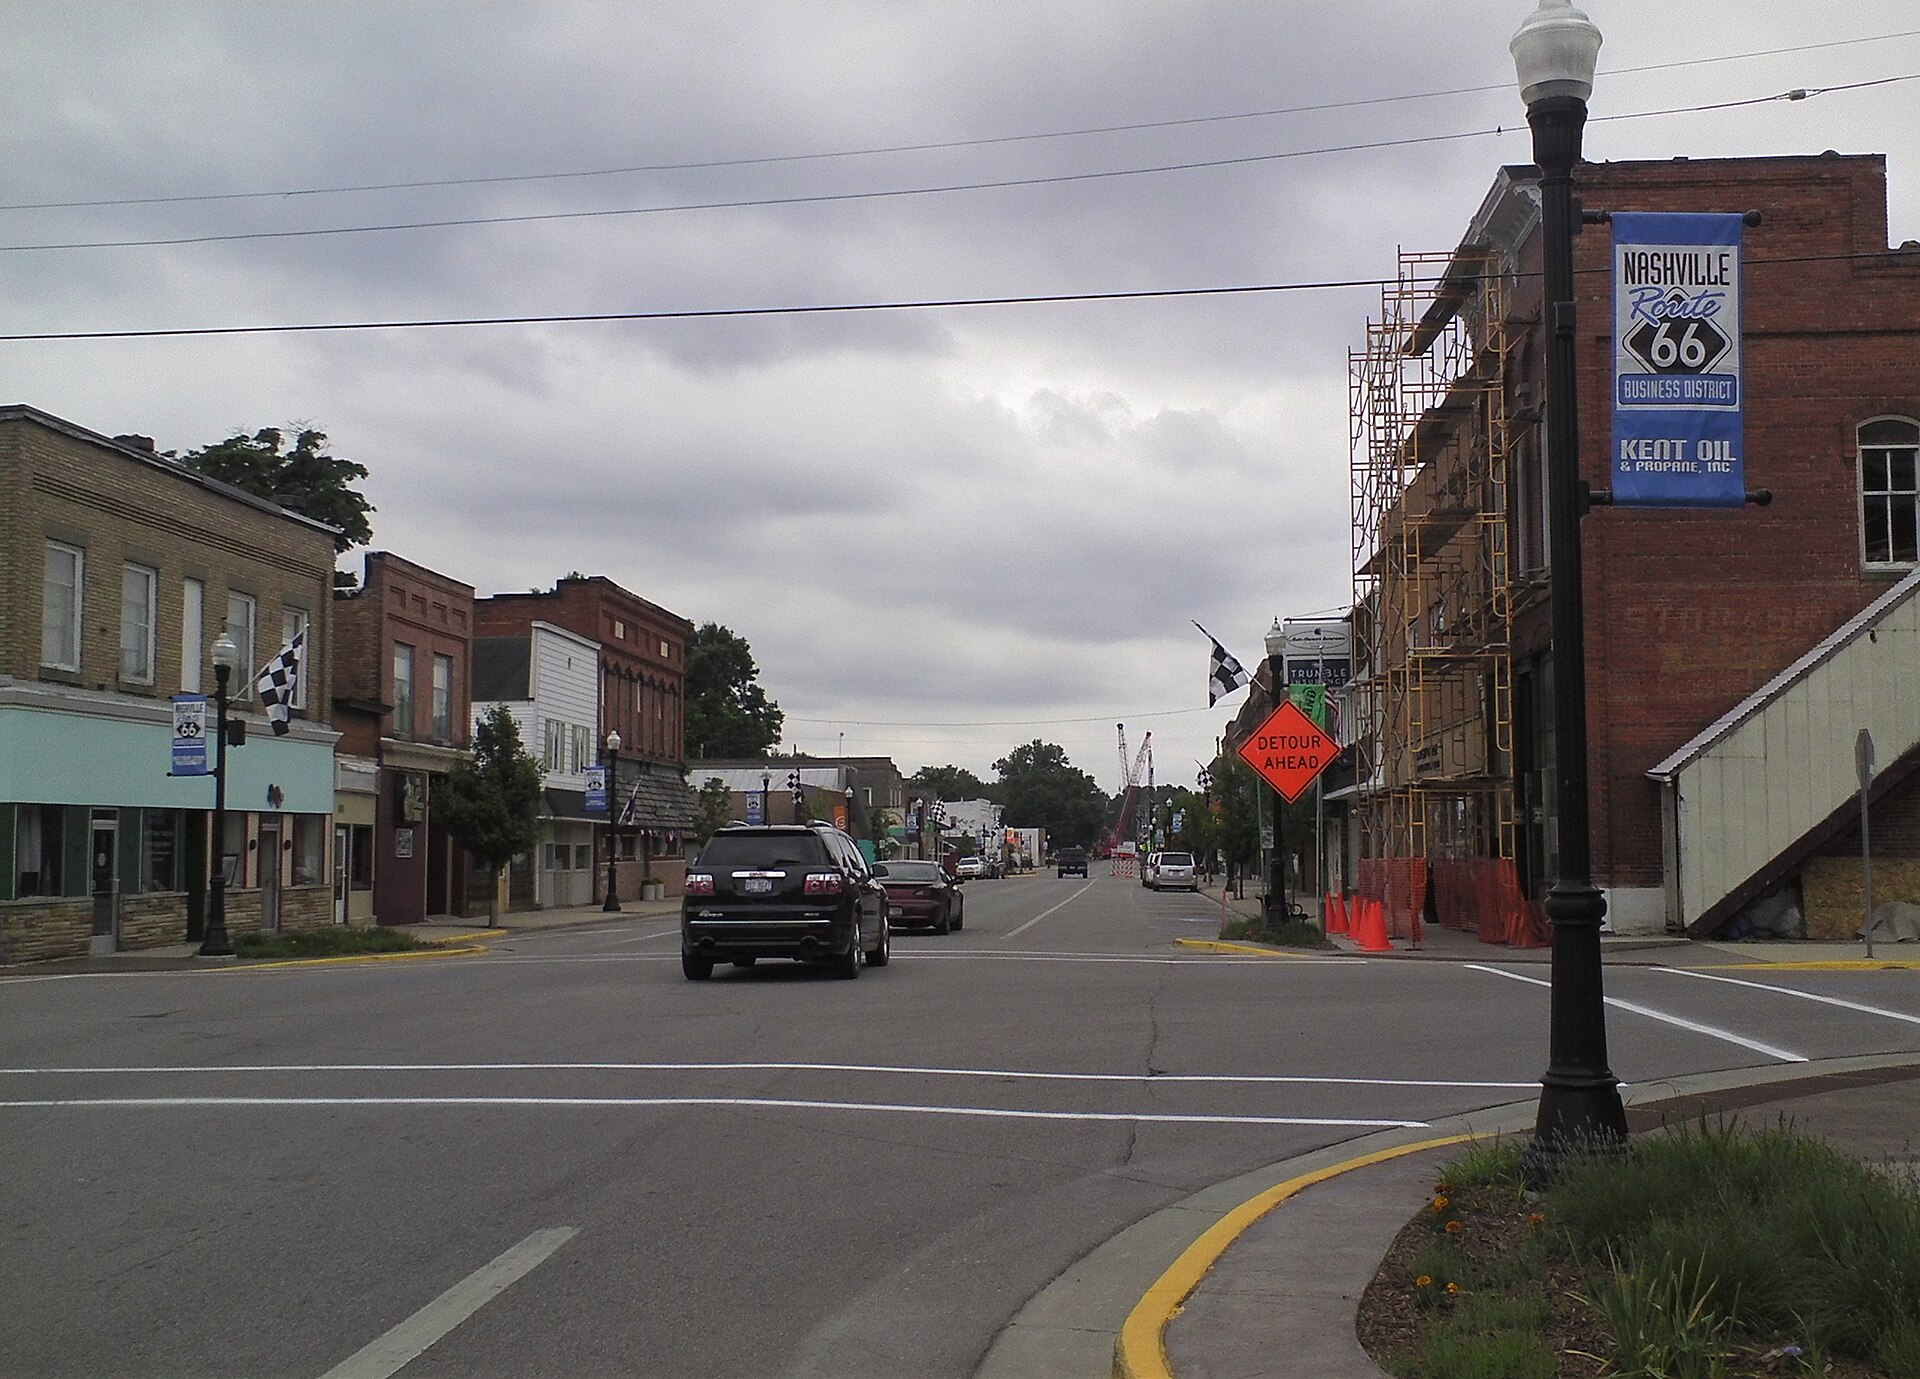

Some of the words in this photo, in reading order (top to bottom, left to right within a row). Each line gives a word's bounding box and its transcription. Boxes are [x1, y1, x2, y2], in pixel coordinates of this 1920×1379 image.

[1624, 251, 1731, 286] NASHVILLE
[1628, 286, 1726, 326] Route
[1650, 322, 1707, 368] 66
[1624, 381, 1680, 400] BUSINESS
[1683, 381, 1732, 400] DISTRICT
[1620, 439, 1687, 461] KENT
[1696, 439, 1737, 462] OIL
[1620, 461, 1631, 472] &
[181, 723, 197, 737] 66
[1258, 736, 1320, 750] DETOUR
[1264, 757, 1319, 769] AHEAD
